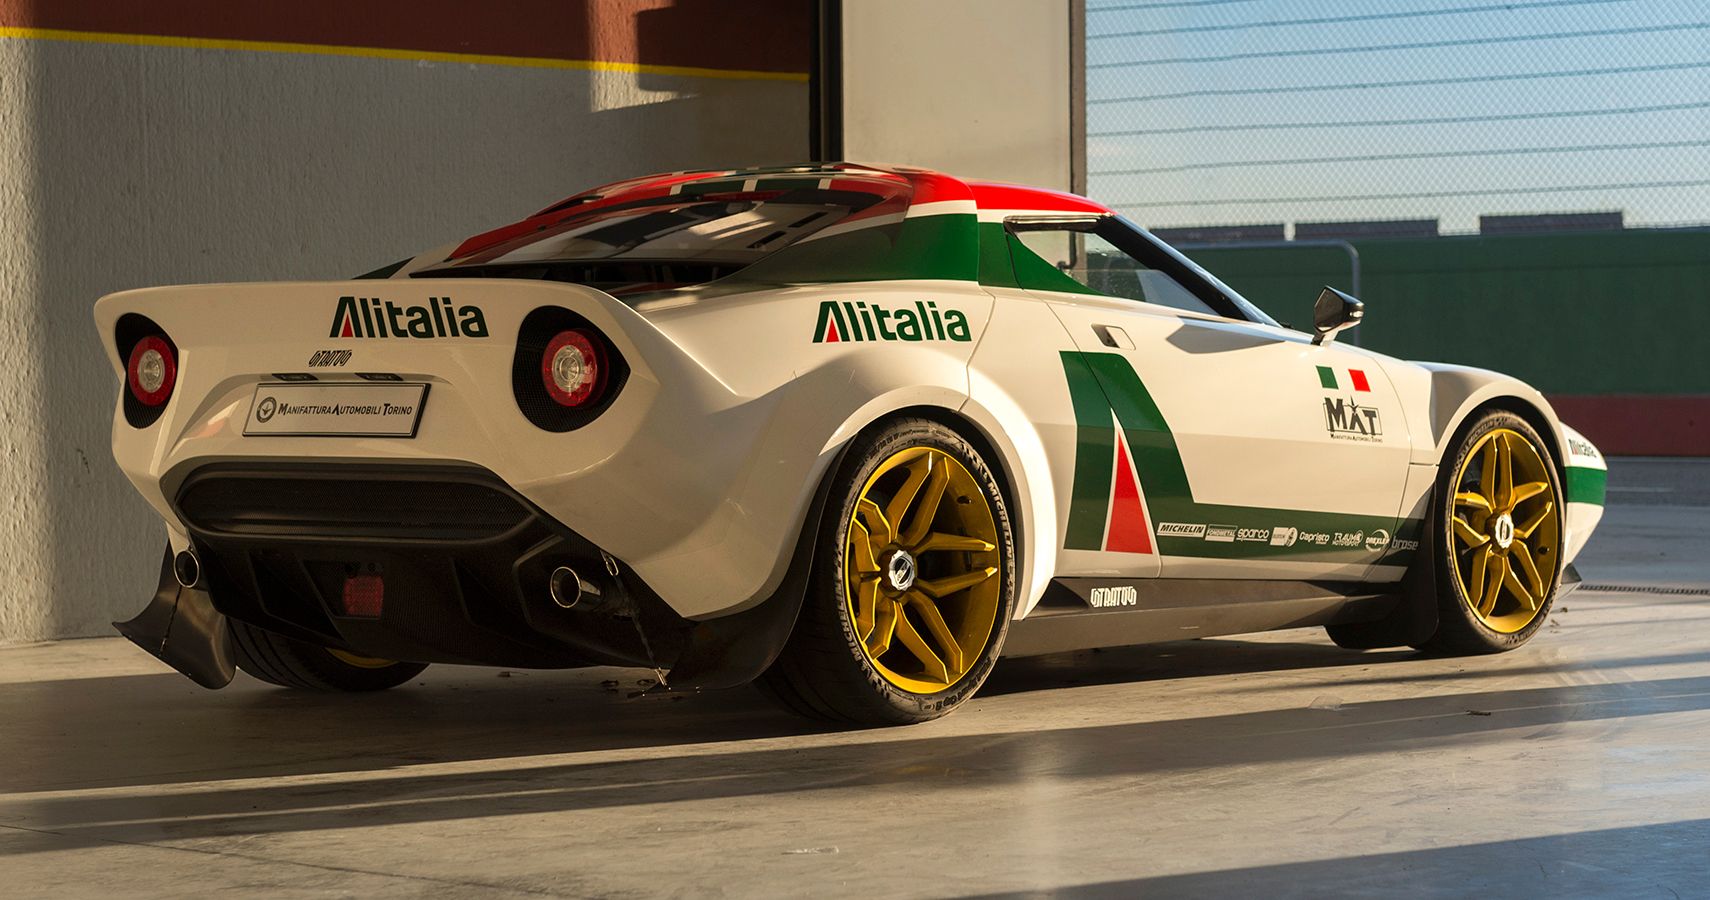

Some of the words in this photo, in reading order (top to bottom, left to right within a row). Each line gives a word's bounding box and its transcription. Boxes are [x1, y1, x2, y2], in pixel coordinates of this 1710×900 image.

[330, 296, 489, 338] Alitalia
[812, 301, 972, 343] Alitalia
[383, 403, 413, 416] TORINO
[1324, 397, 1377, 435] MAT
[1160, 524, 1204, 533] MICHELIN
[1238, 528, 1269, 539] sparco
[1299, 531, 1330, 542] Capristo
[1391, 535, 1419, 551] brose
